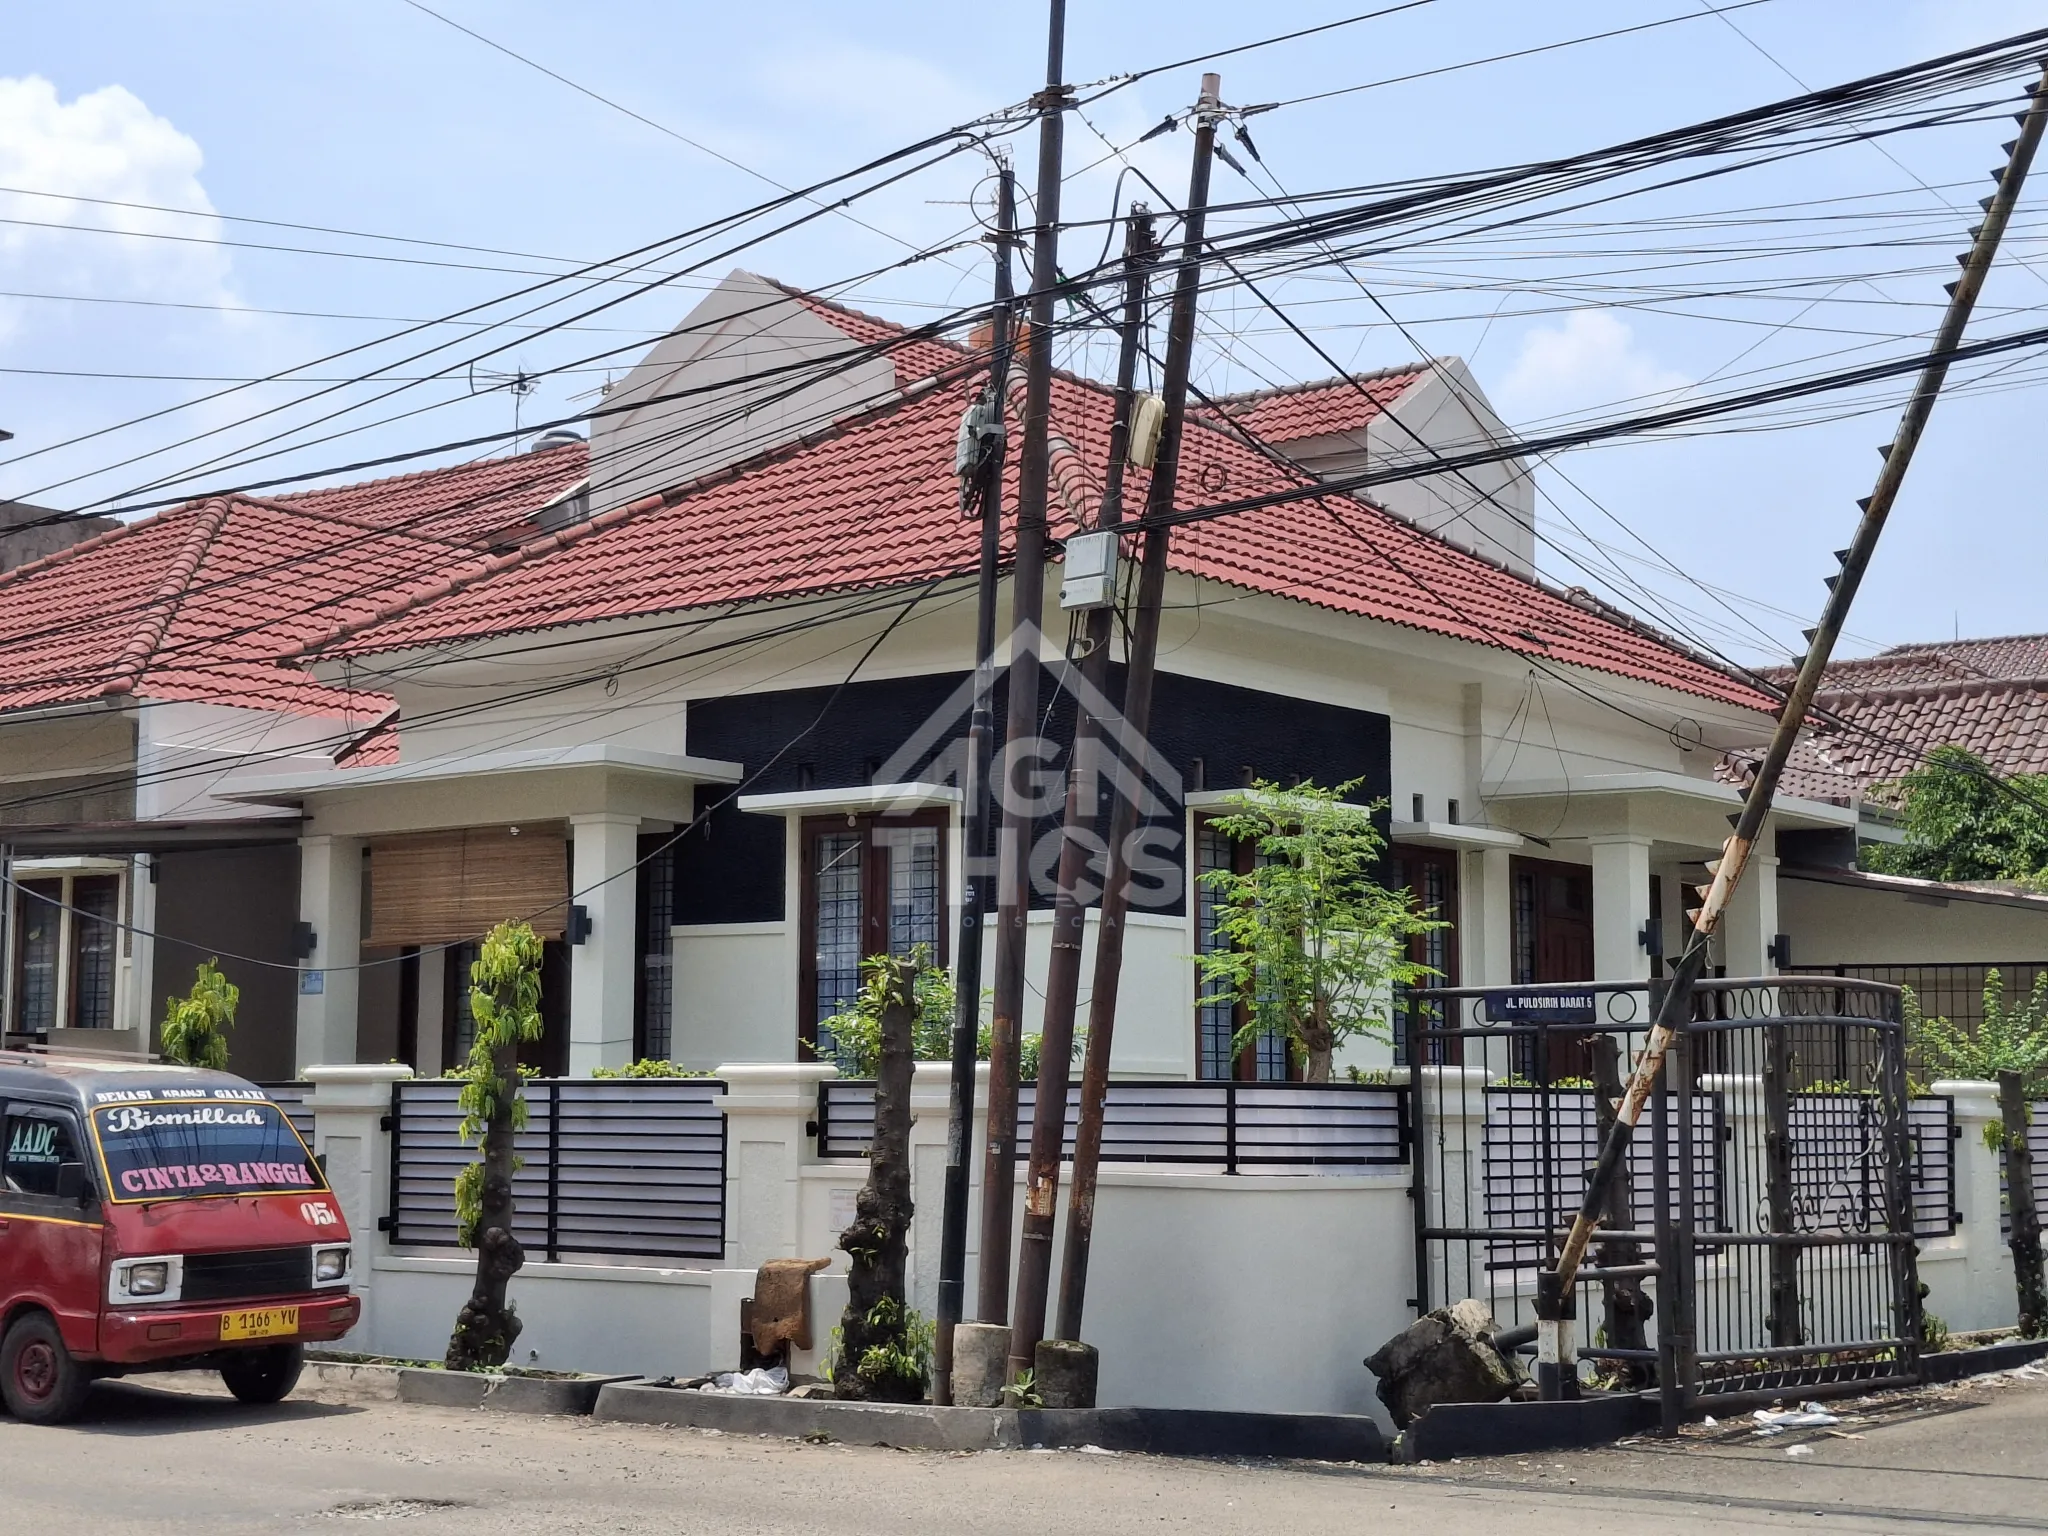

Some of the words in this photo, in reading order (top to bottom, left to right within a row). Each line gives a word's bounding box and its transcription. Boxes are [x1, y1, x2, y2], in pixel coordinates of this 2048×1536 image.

[1560, 997, 1585, 1009] BARAT
[95, 1090, 154, 1102] BEKASI
[161, 1089, 206, 1098] KRANJI
[214, 1089, 266, 1100] GALAXI
[107, 1107, 265, 1133] Bismillah
[9, 1121, 60, 1156] AADC
[222, 1315, 230, 1330] B
[239, 1312, 270, 1329] 1166
